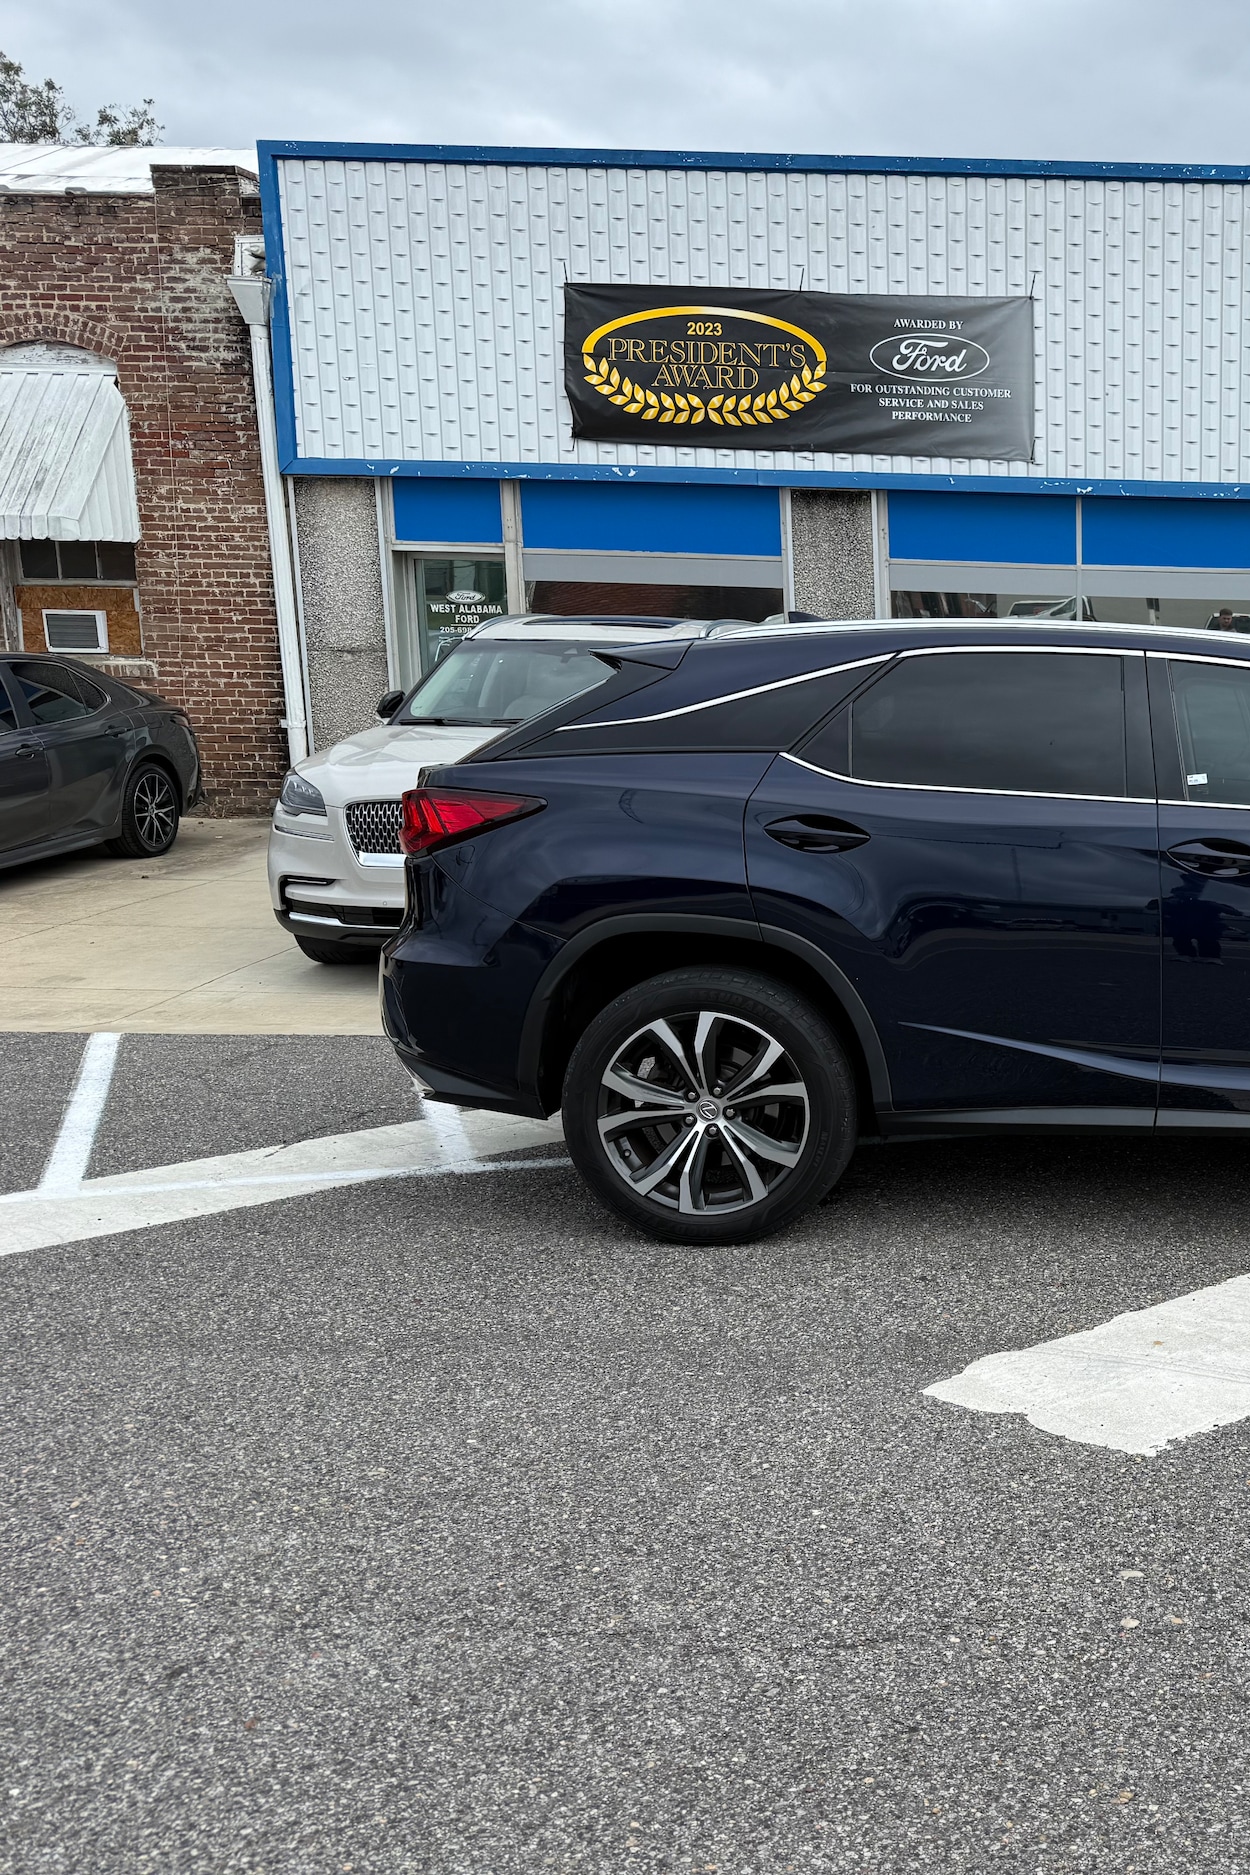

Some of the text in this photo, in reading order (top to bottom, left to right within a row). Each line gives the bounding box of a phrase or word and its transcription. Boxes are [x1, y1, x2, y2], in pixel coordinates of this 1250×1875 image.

[686, 321, 723, 336] 2023
[893, 318, 963, 330] AWARDED BY
[607, 337, 807, 368] PRESIDENT'S
[892, 339, 967, 372] Ford
[651, 364, 759, 390] AWARD
[850, 384, 1012, 398] FOR OUTSTANDING CUSTOMER
[879, 398, 984, 411] SERVICE AND SALES
[892, 411, 972, 423] PERFORMANCE
[455, 592, 476, 600] Ford
[430, 604, 503, 614] WEST ALABAMA
[455, 615, 480, 623] FORD
